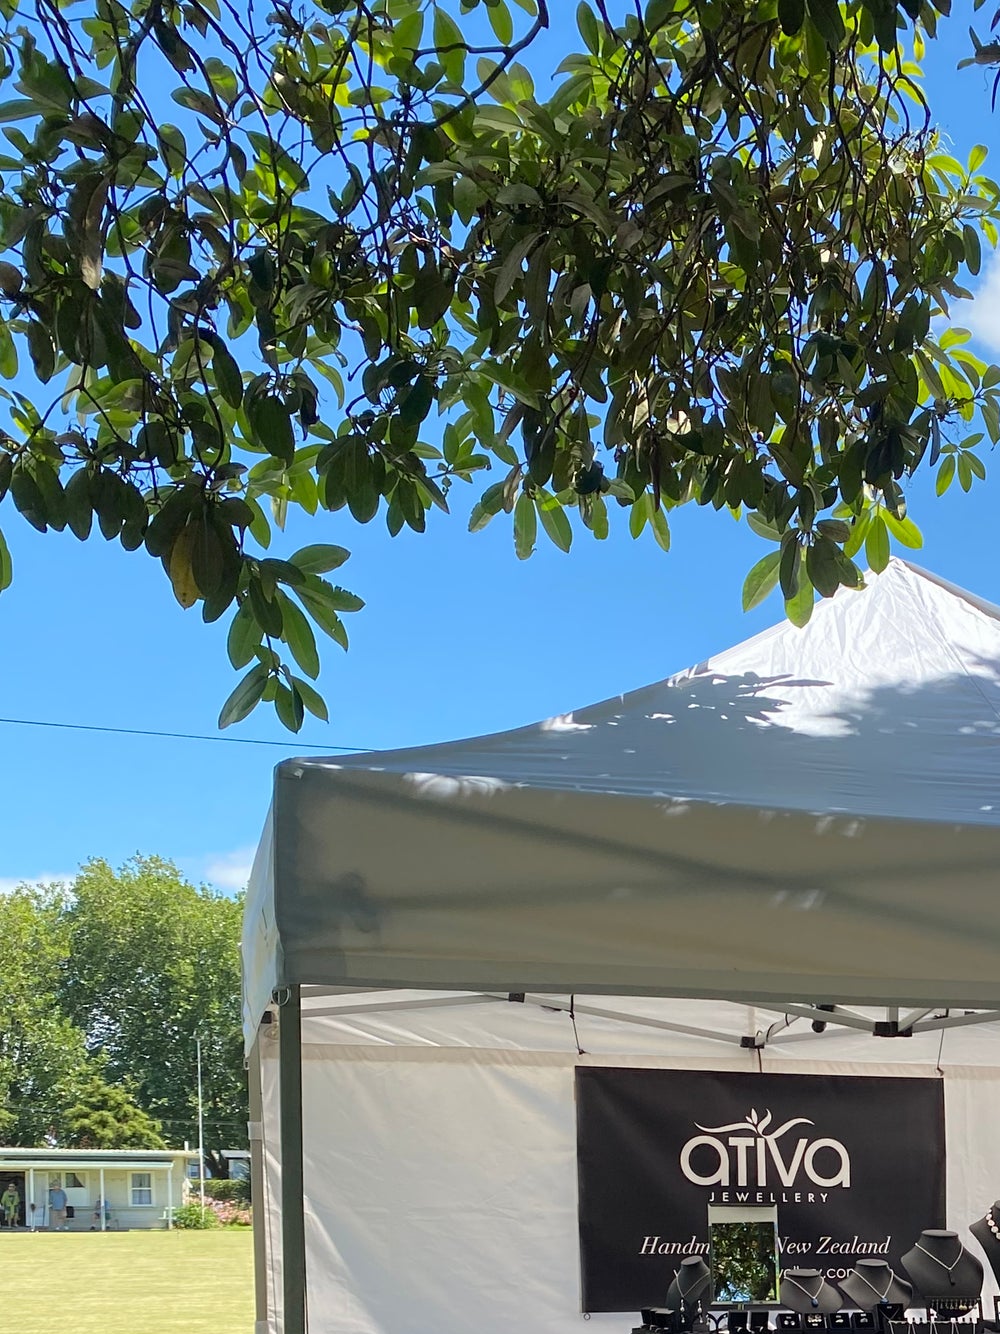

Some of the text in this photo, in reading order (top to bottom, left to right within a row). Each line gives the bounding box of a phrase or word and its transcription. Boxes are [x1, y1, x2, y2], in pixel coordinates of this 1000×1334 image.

[709, 1191, 829, 1203] JEWELLERY
[639, 1235, 711, 1255] Handm
[816, 1236, 891, 1255] Zealand
